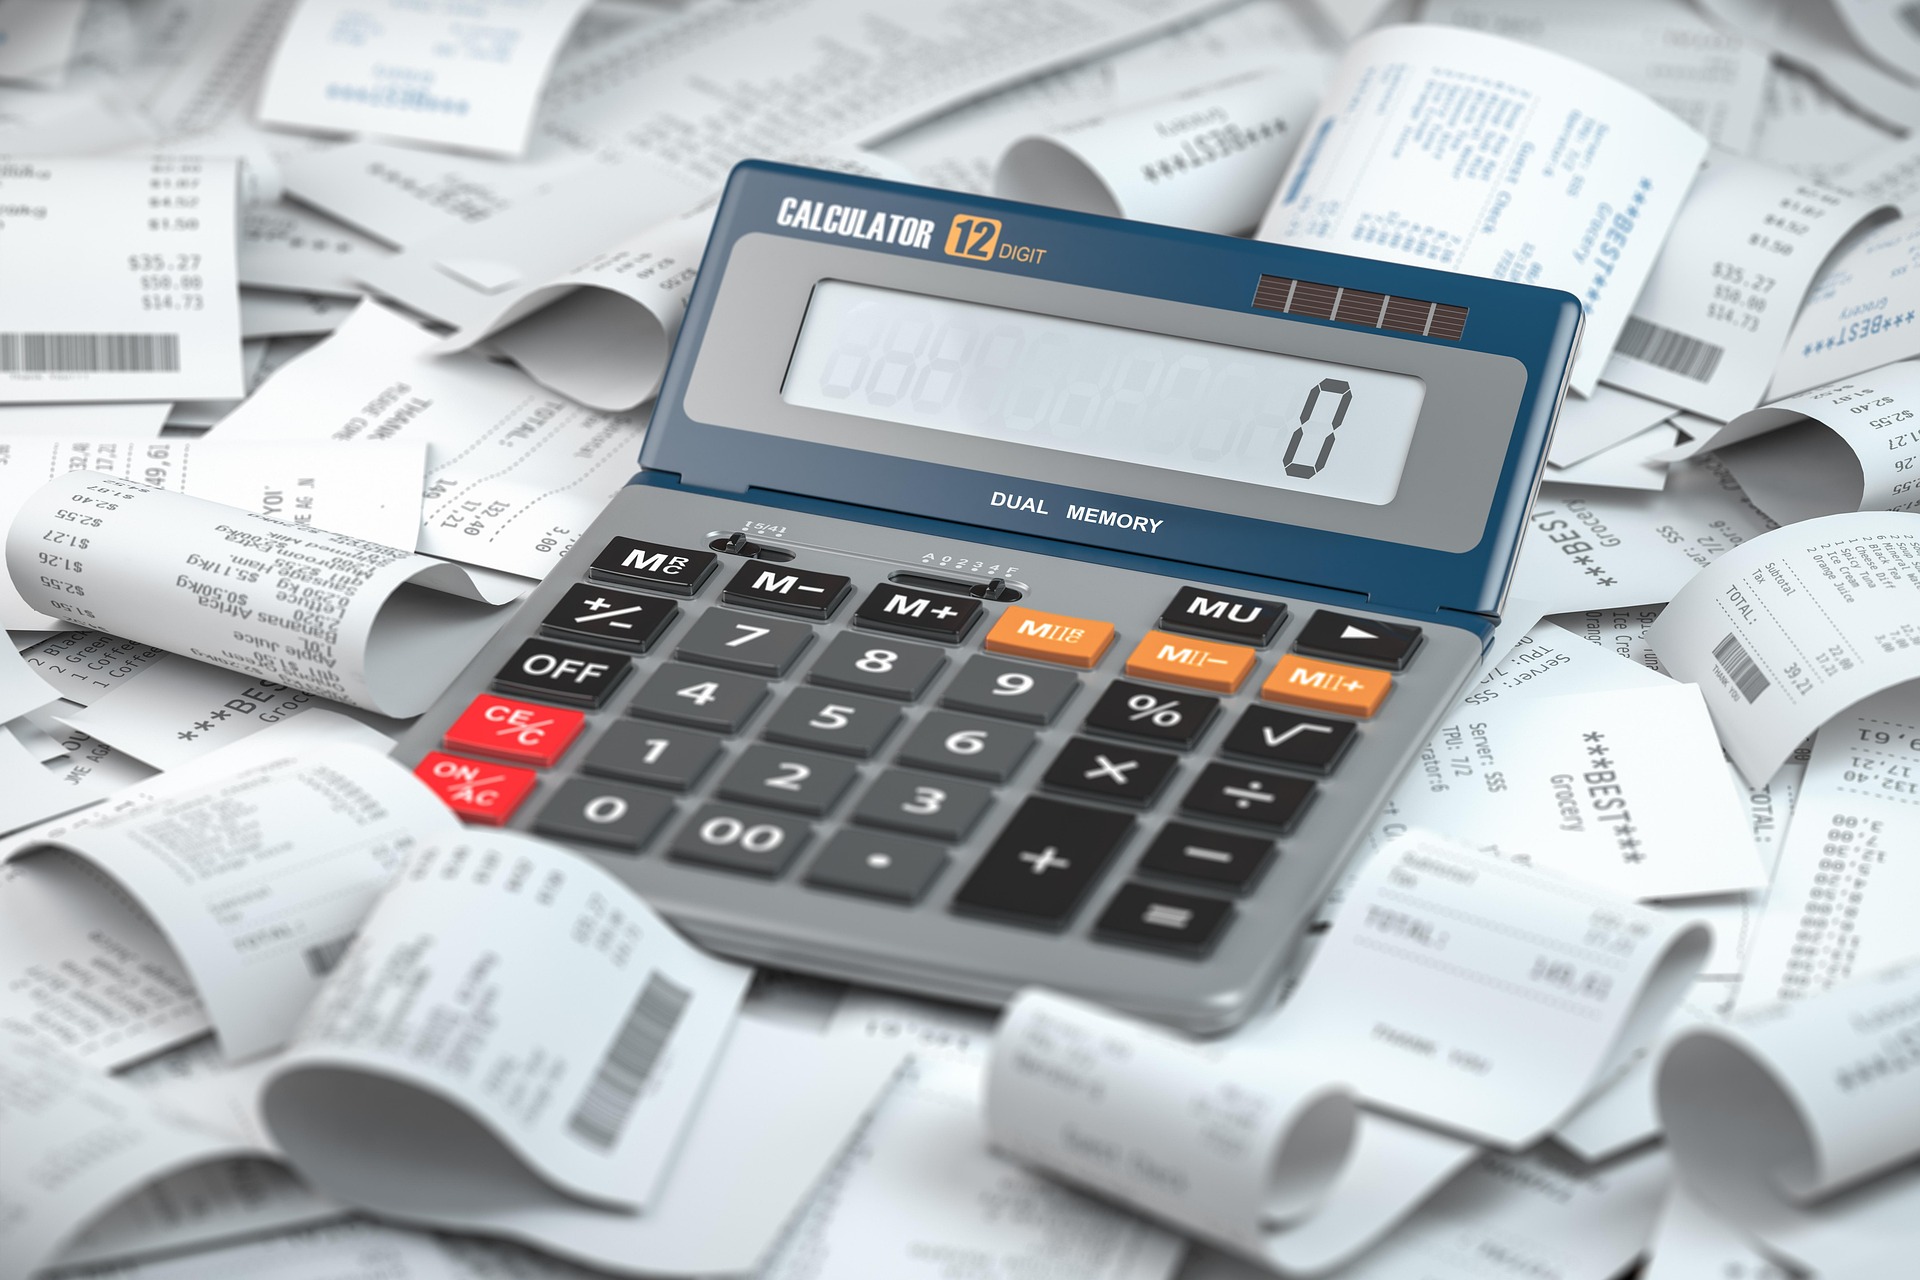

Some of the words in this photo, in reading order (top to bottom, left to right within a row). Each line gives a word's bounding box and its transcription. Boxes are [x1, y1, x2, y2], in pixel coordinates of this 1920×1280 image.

[776, 196, 936, 250] CALCULATOR
[951, 218, 999, 259] 12
[999, 242, 1048, 265] DIGIT
[127, 253, 202, 272] $35.27
[139, 274, 203, 291] $50.00
[1711, 260, 1777, 294] $35.27
[141, 294, 205, 311] $14.73
[1713, 283, 1768, 313] $50.00
[1706, 301, 1761, 333] $14.73
[1850, 396, 1894, 414] $2.40
[1283, 378, 1353, 480] 0
[1869, 409, 1914, 430] $2.55
[71, 493, 119, 511] $2.40
[440, 501, 482, 529] 17,21
[990, 491, 1049, 515] DUAL
[1066, 504, 1164, 535] MEMORY
[54, 508, 104, 528] $2.55
[463, 500, 511, 536] 132,40
[42, 529, 91, 550] $1.27
[535, 526, 570, 553] 3,00
[1655, 524, 1685, 544] SSS
[38, 551, 84, 574] $1.26
[186, 553, 260, 584] $5.11/kg
[1826, 551, 1841, 565] Ice
[1839, 566, 1860, 588] Cream
[1840, 548, 1861, 570] Spicy
[1859, 570, 1877, 589] Tuna
[1854, 545, 1878, 571] Cheese
[1875, 572, 1897, 589] Diff
[1868, 543, 1891, 565] Black
[1887, 566, 1902, 581] Tea
[1882, 542, 1911, 570] Mineral
[40, 575, 85, 597] $2.55
[1751, 567, 1767, 585] Tax
[1764, 562, 1796, 597] Subtotal
[1812, 554, 1837, 580] Orange
[1833, 582, 1855, 604] Juice
[176, 574, 249, 607] $0.50/kg
[50, 599, 96, 619] $1.50
[275, 590, 346, 620] Lettuce
[883, 593, 958, 620] M+
[1187, 596, 1263, 624] MU
[232, 630, 280, 652] Juice
[725, 623, 769, 647] 7
[1725, 584, 1758, 625] TOTAL:
[1783, 661, 1814, 696] 39,21
[28, 656, 46, 667] 2
[522, 653, 609, 684] OFF
[855, 649, 898, 672] 8
[1511, 645, 1554, 666] TPU:
[49, 664, 67, 675] 2
[71, 672, 88, 682] 1
[1503, 653, 1571, 689] Server:
[1712, 664, 1730, 688] THANK
[92, 680, 110, 689] 1
[676, 681, 720, 707] 4
[992, 672, 1035, 695] 9
[1464, 688, 1499, 705] SSS
[809, 703, 855, 730] 5
[944, 730, 988, 754] 6
[1442, 724, 1464, 750] TPU:
[642, 738, 670, 765] 1
[1469, 721, 1495, 766] Server:
[1484, 771, 1508, 793] SSS
[765, 762, 811, 790] 2
[1450, 756, 1474, 777] 7/2
[1850, 756, 1912, 779] 17,21
[1843, 770, 1920, 795] 132,40
[584, 795, 628, 823] 0
[902, 786, 947, 815] 3
[1549, 774, 1585, 833] Grocery
[700, 816, 785, 852] 00
